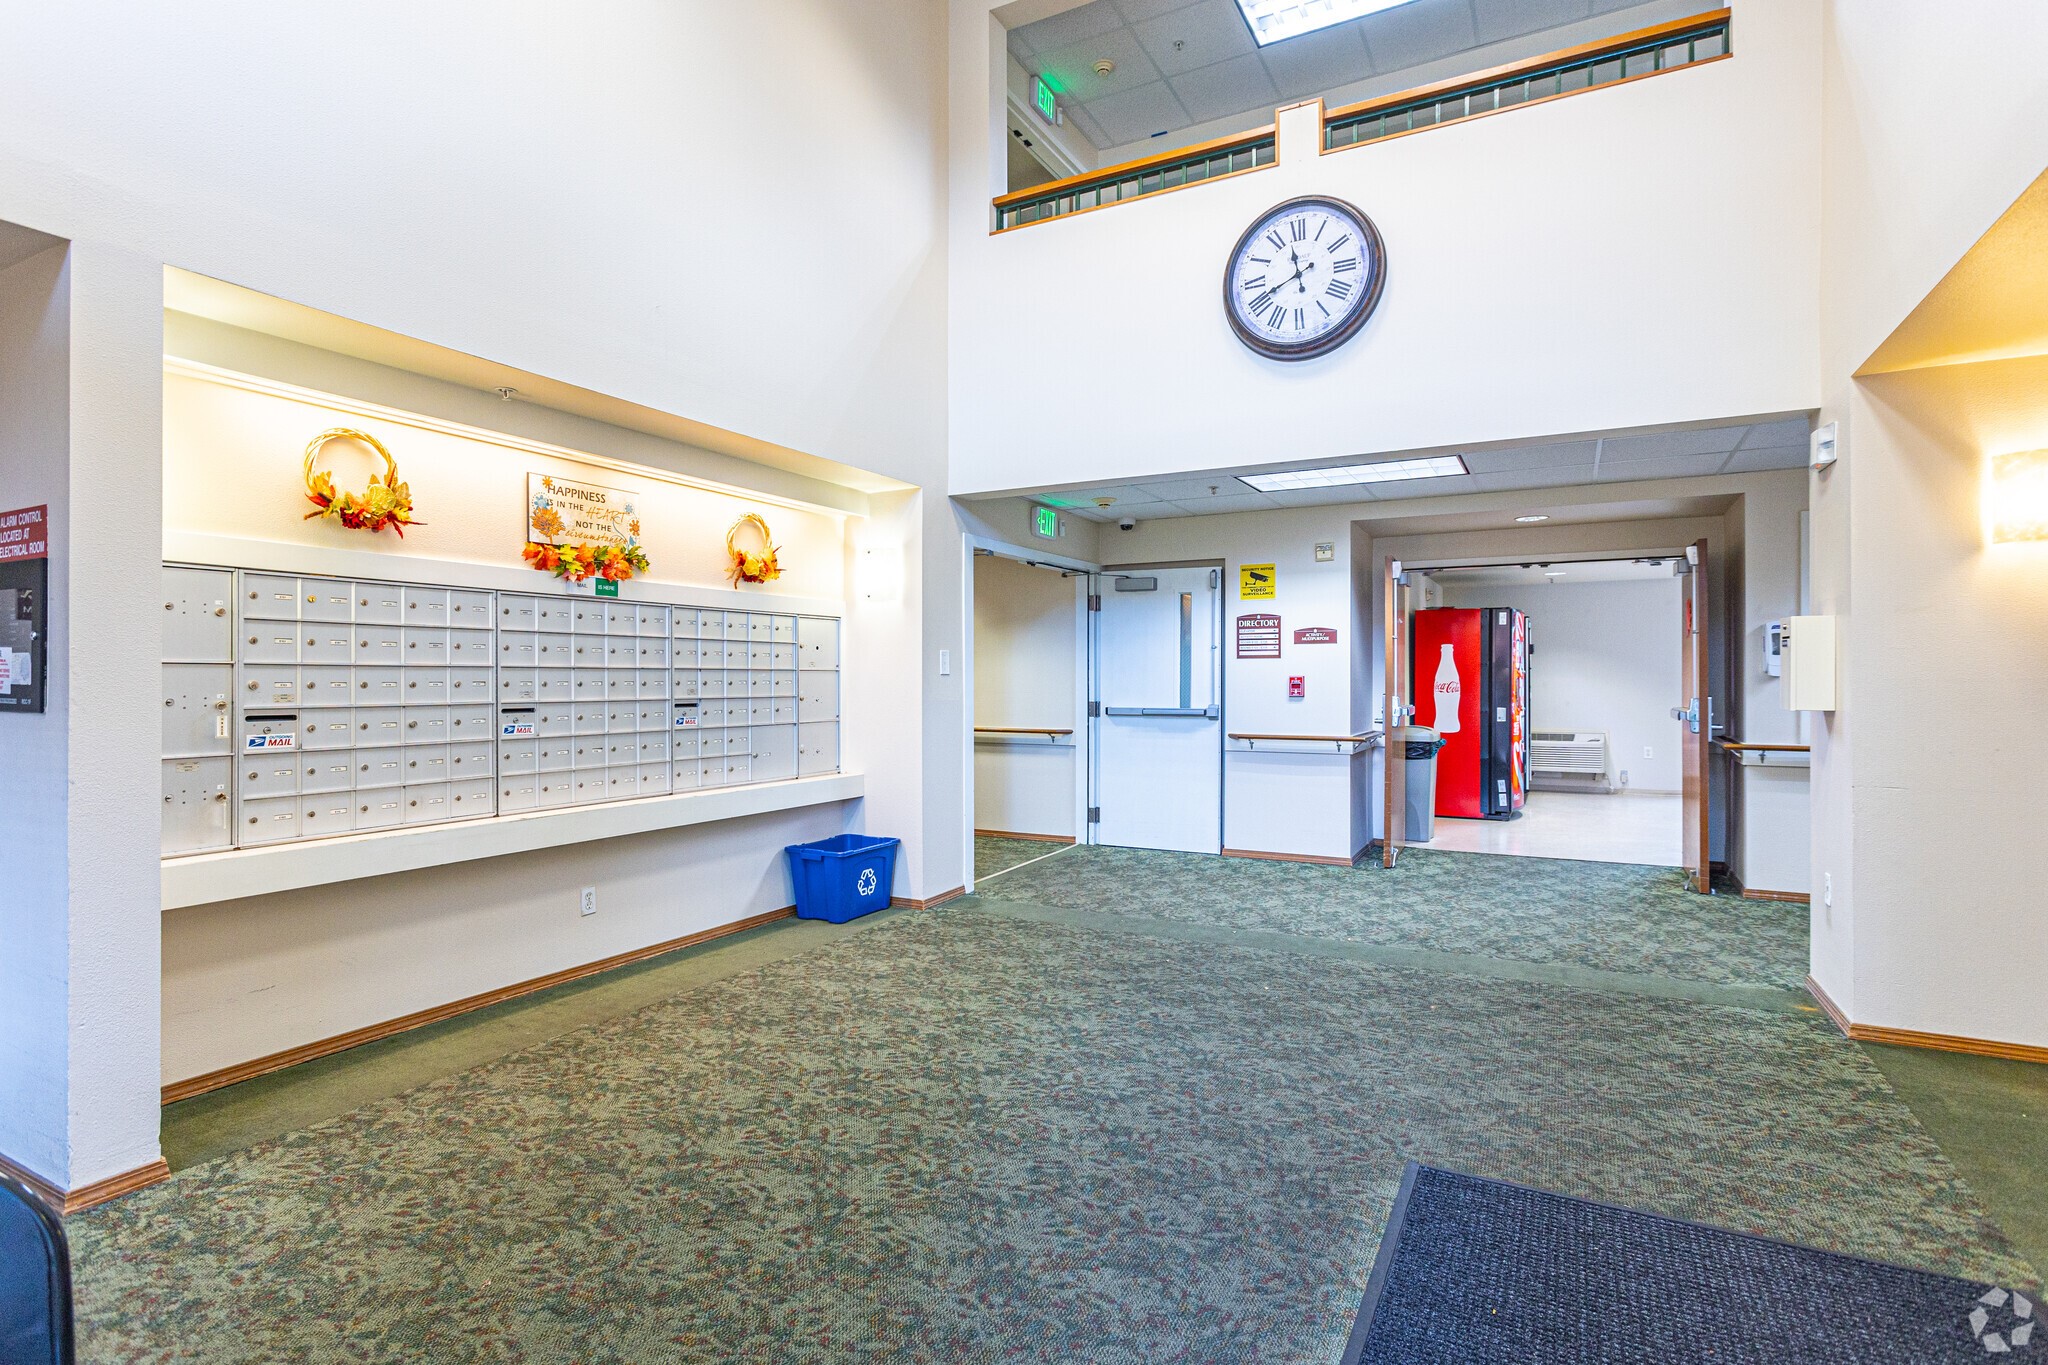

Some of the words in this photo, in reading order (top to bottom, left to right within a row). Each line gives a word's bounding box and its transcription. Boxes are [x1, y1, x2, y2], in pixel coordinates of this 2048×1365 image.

[1038, 80, 1054, 119] EXIT
[547, 485, 606, 504] HAPPINESS
[0, 514, 17, 528] ALARM
[18, 510, 42, 525] CONTROL
[556, 500, 566, 508] IN
[568, 502, 584, 512] THE
[586, 506, 630, 524] HEART
[575, 520, 593, 530] NOT
[596, 523, 612, 532] THE
[1039, 508, 1056, 537] EXIT
[0, 529, 22, 543] LOCATED
[23, 528, 30, 540] AT
[0, 544, 28, 559] ELECTRICAL
[29, 541, 45, 554] ROOM
[1238, 619, 1279, 627] DIRECTORY
[1434, 681, 1460, 693] oca-Cola
[268, 739, 292, 747] MAIL
